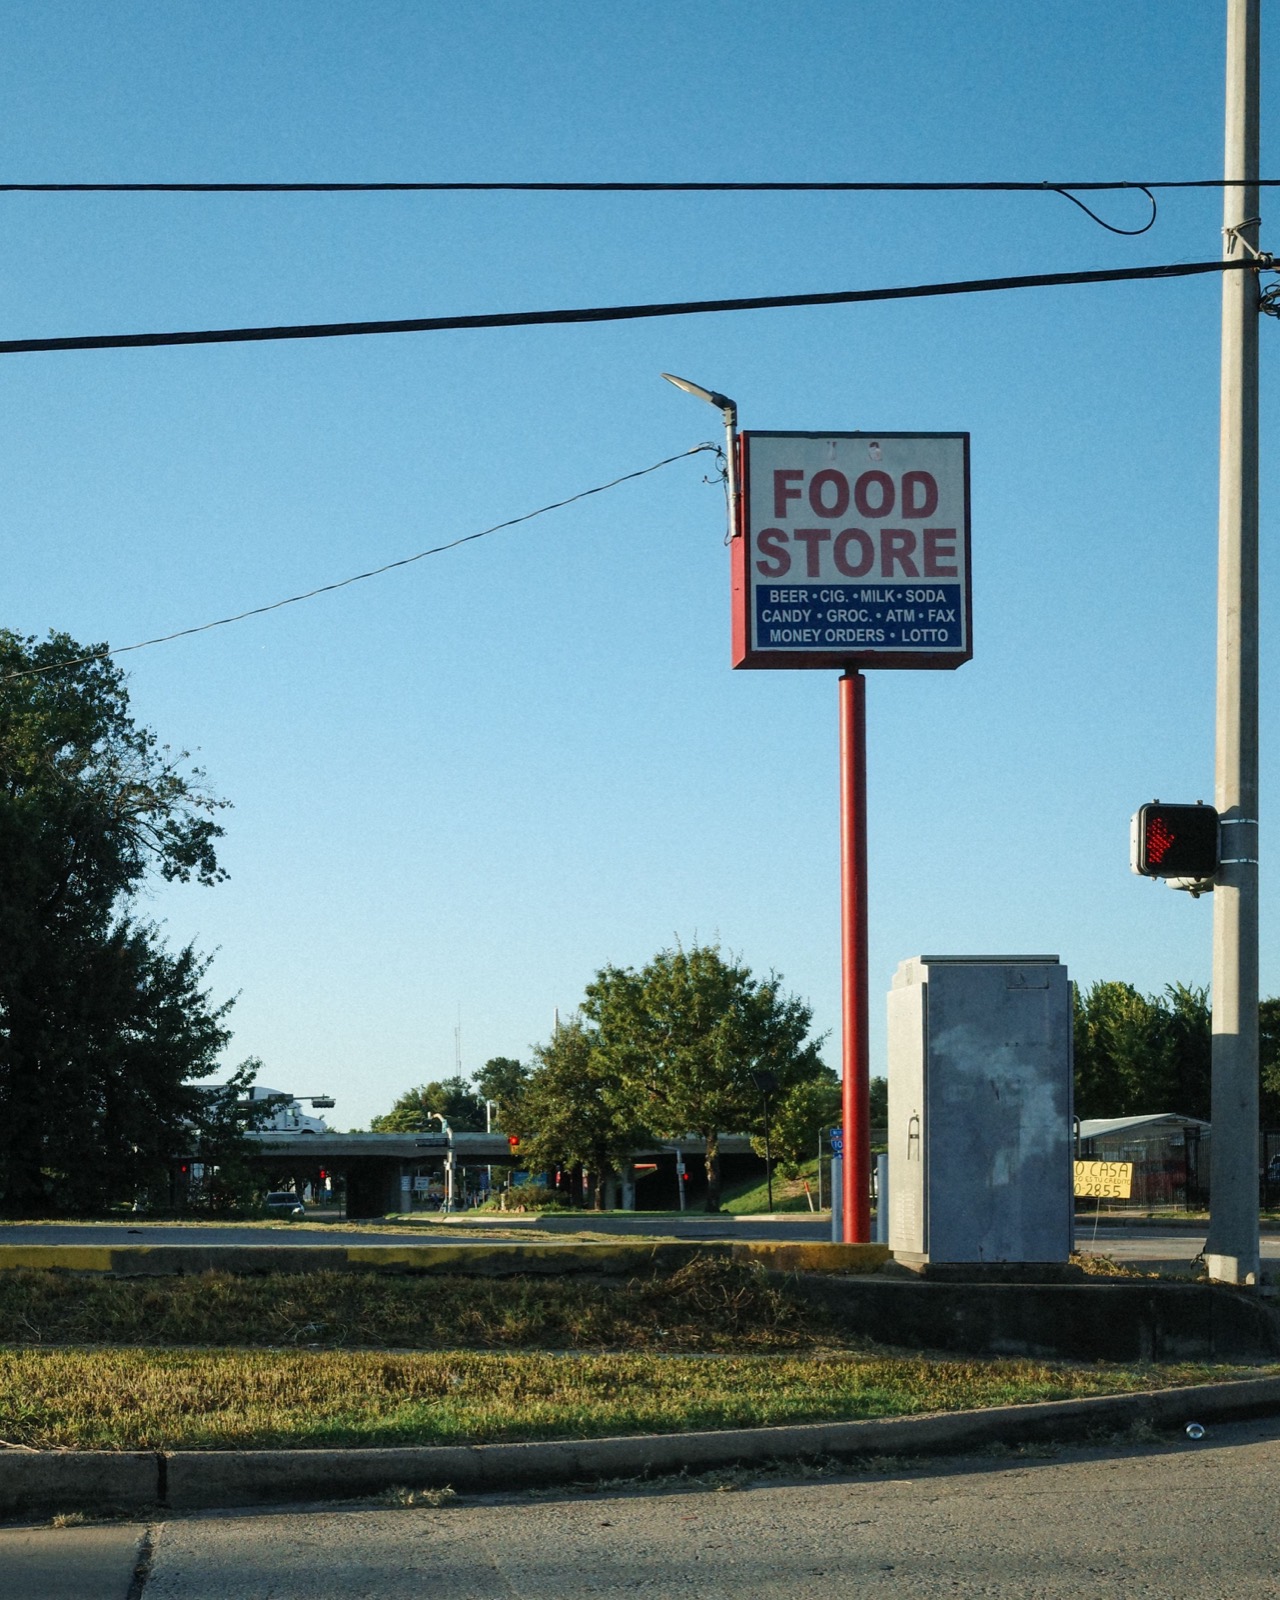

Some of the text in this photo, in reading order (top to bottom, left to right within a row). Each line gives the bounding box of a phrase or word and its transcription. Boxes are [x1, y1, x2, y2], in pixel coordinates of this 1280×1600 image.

[773, 469, 939, 519] FOOD
[756, 528, 958, 578] STORE
[770, 590, 946, 602] BEER CIG. MILK SODA
[762, 610, 955, 623] CANDY GROC. ATM FAX
[770, 629, 948, 642] MONEY ORDERS LOTTO
[1090, 1162, 1128, 1177] CASA
